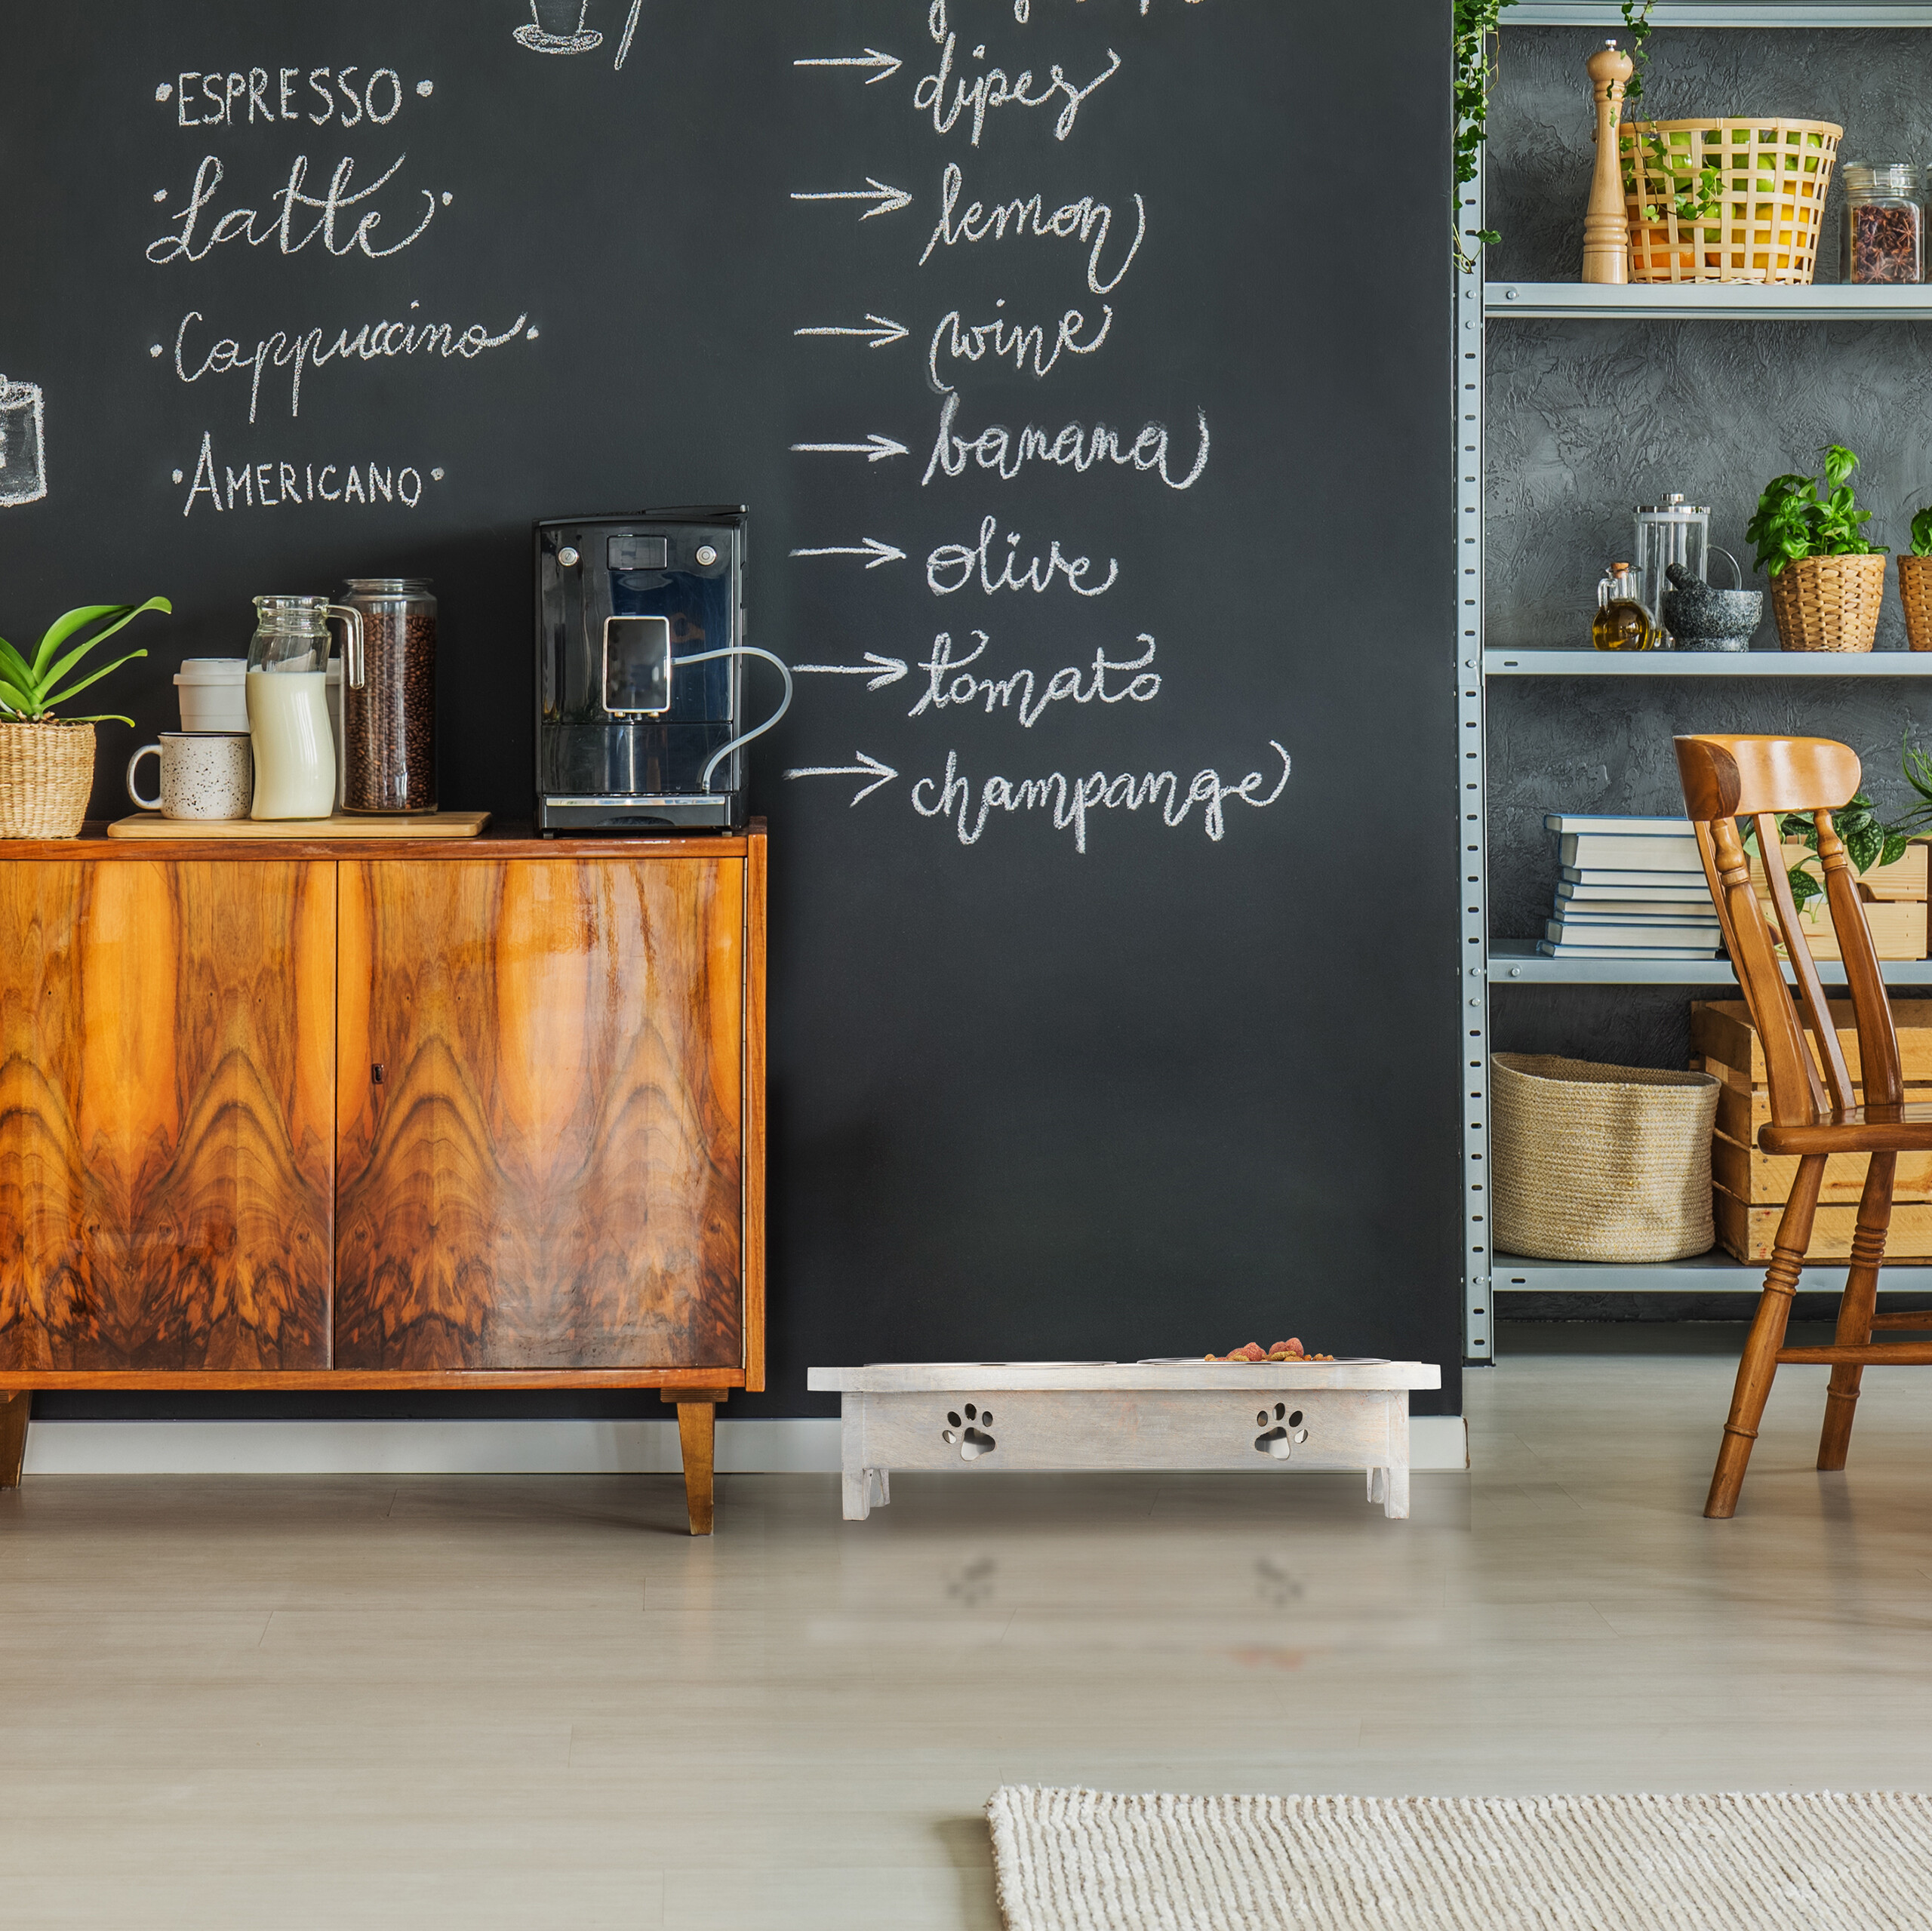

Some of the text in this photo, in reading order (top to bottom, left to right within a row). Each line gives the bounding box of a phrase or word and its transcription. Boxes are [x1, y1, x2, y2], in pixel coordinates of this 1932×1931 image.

[178, 66, 402, 127] ESPRESSO
[146, 152, 435, 263] Latte
[918, 162, 1145, 294] lemon
[929, 299, 1112, 391] wine
[922, 392, 1209, 490] banana
[927, 515, 1118, 596] olive
[908, 630, 1162, 727] tomato
[911, 739, 1291, 853] champange
